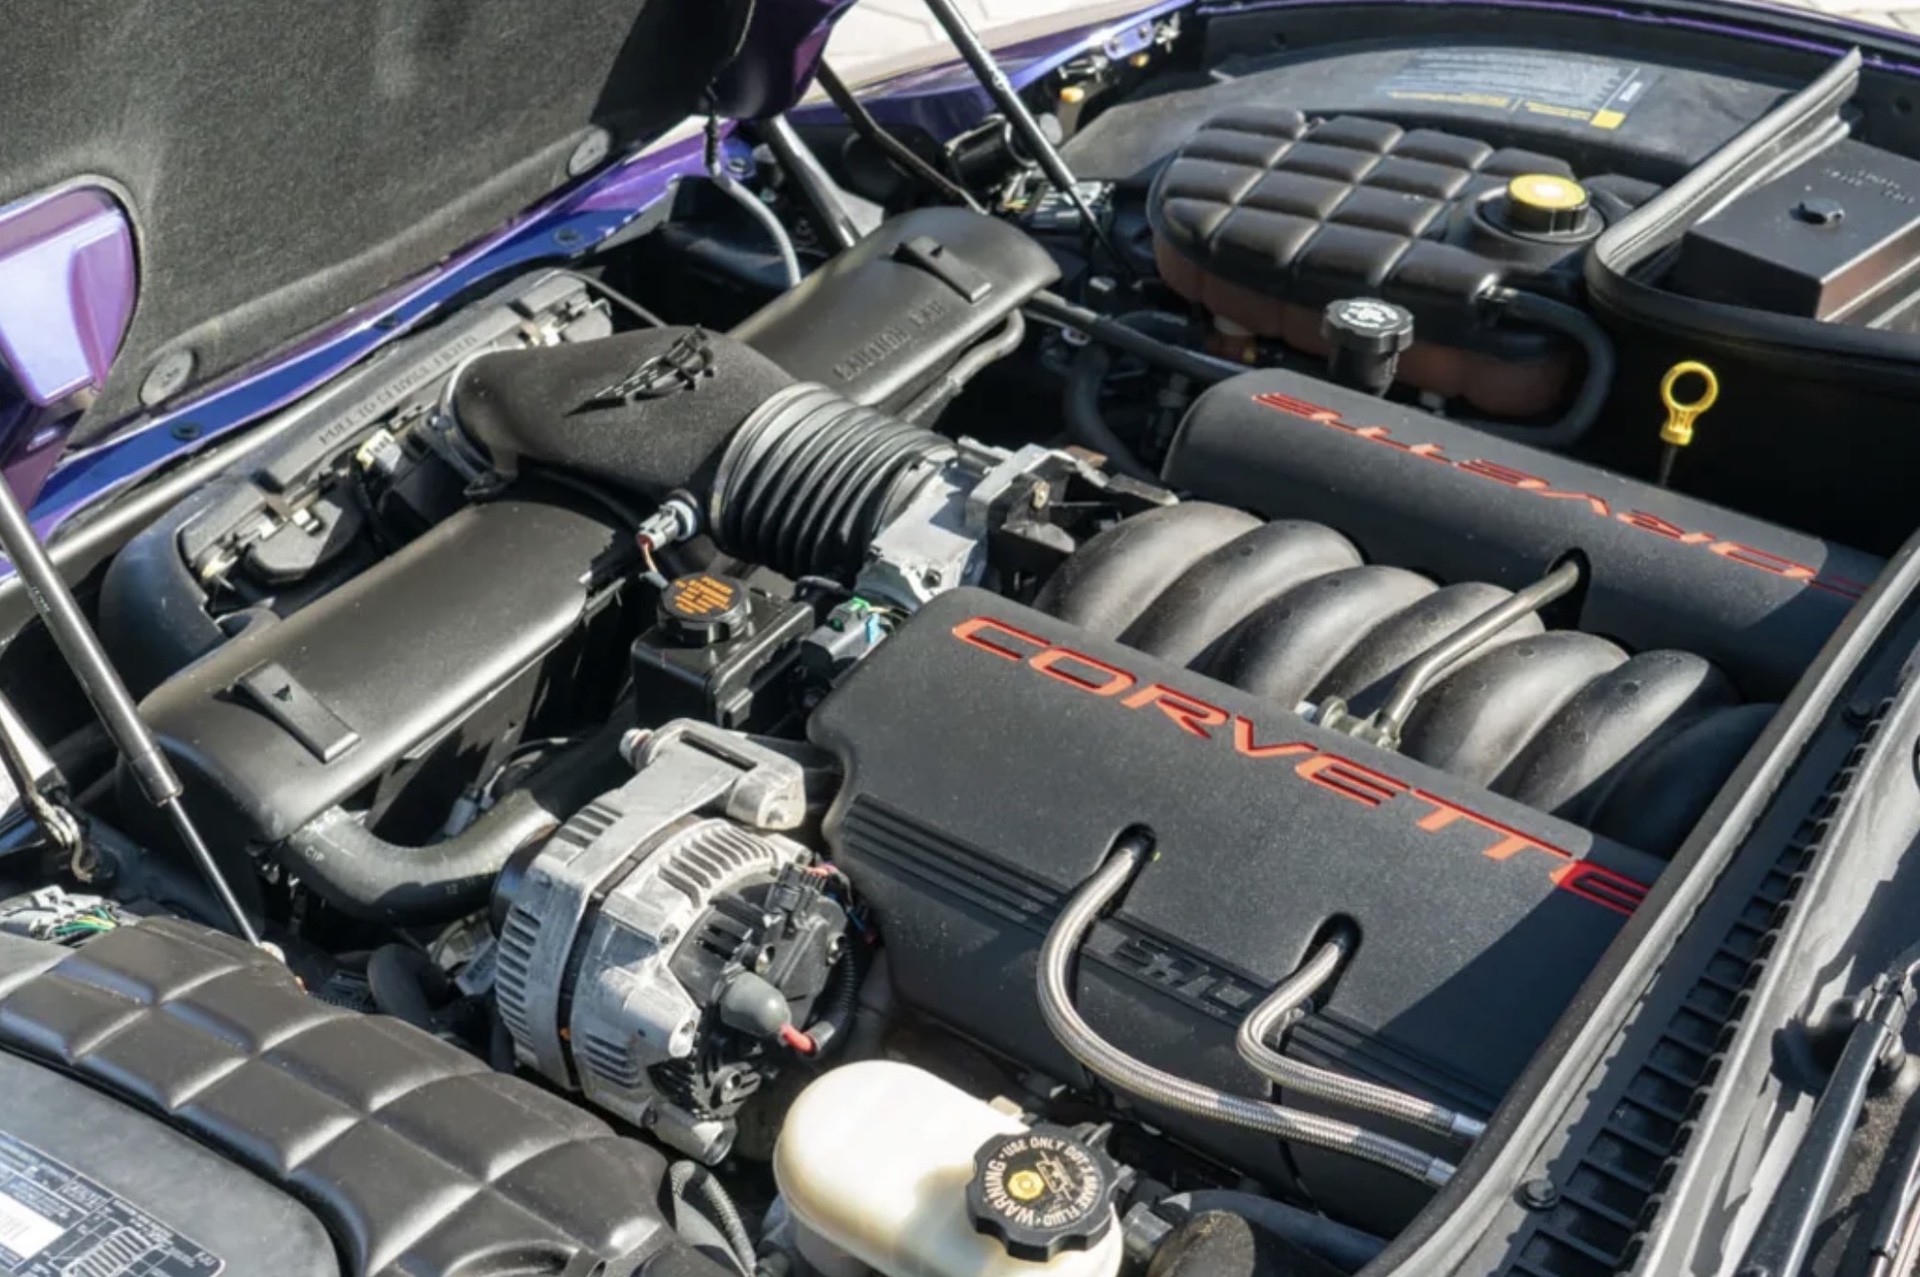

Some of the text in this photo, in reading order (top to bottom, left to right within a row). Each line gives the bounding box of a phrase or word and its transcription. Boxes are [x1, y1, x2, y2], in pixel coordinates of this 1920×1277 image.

[952, 616, 1652, 917] CORVETTE
[1002, 1138, 1029, 1158] USE
[1029, 1136, 1066, 1152] ONLY
[983, 1159, 1035, 1227] WARNING
[1042, 1204, 1081, 1228] FLUID
